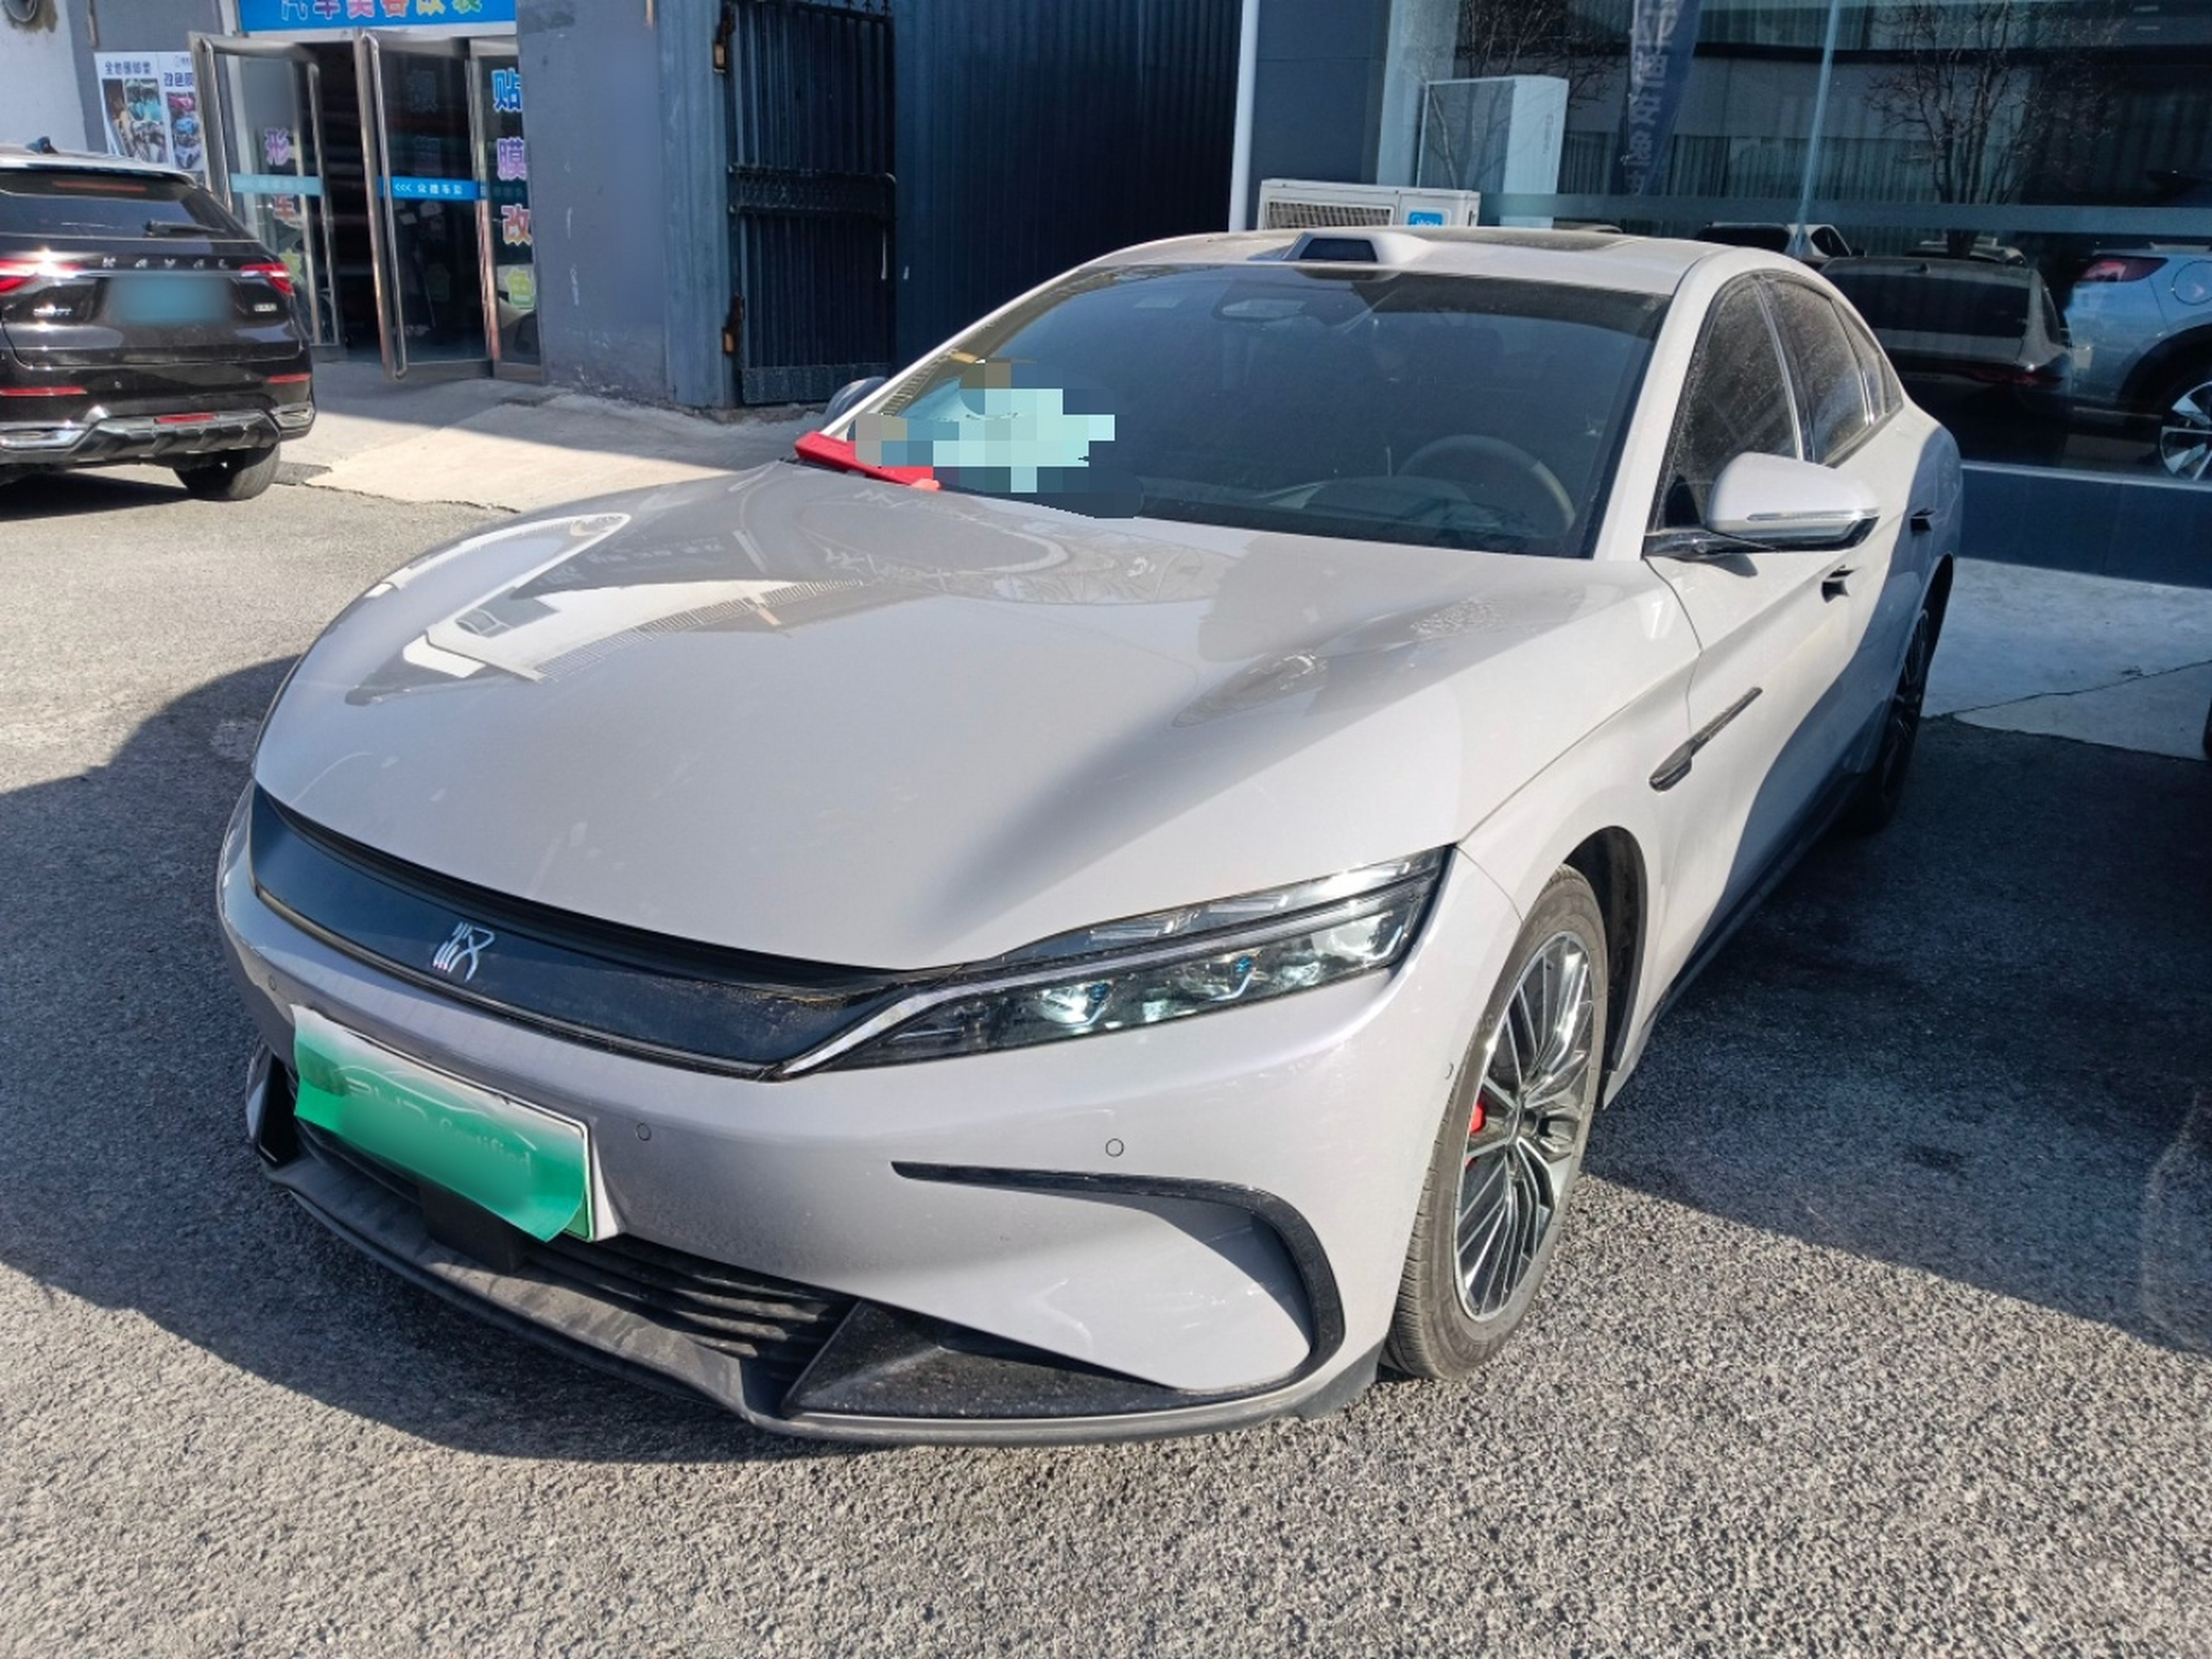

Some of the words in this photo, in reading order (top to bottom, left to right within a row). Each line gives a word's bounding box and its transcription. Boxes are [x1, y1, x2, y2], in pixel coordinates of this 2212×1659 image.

[491, 69, 536, 309] 贴膜改色
[102, 256, 229, 270] HAVAL
